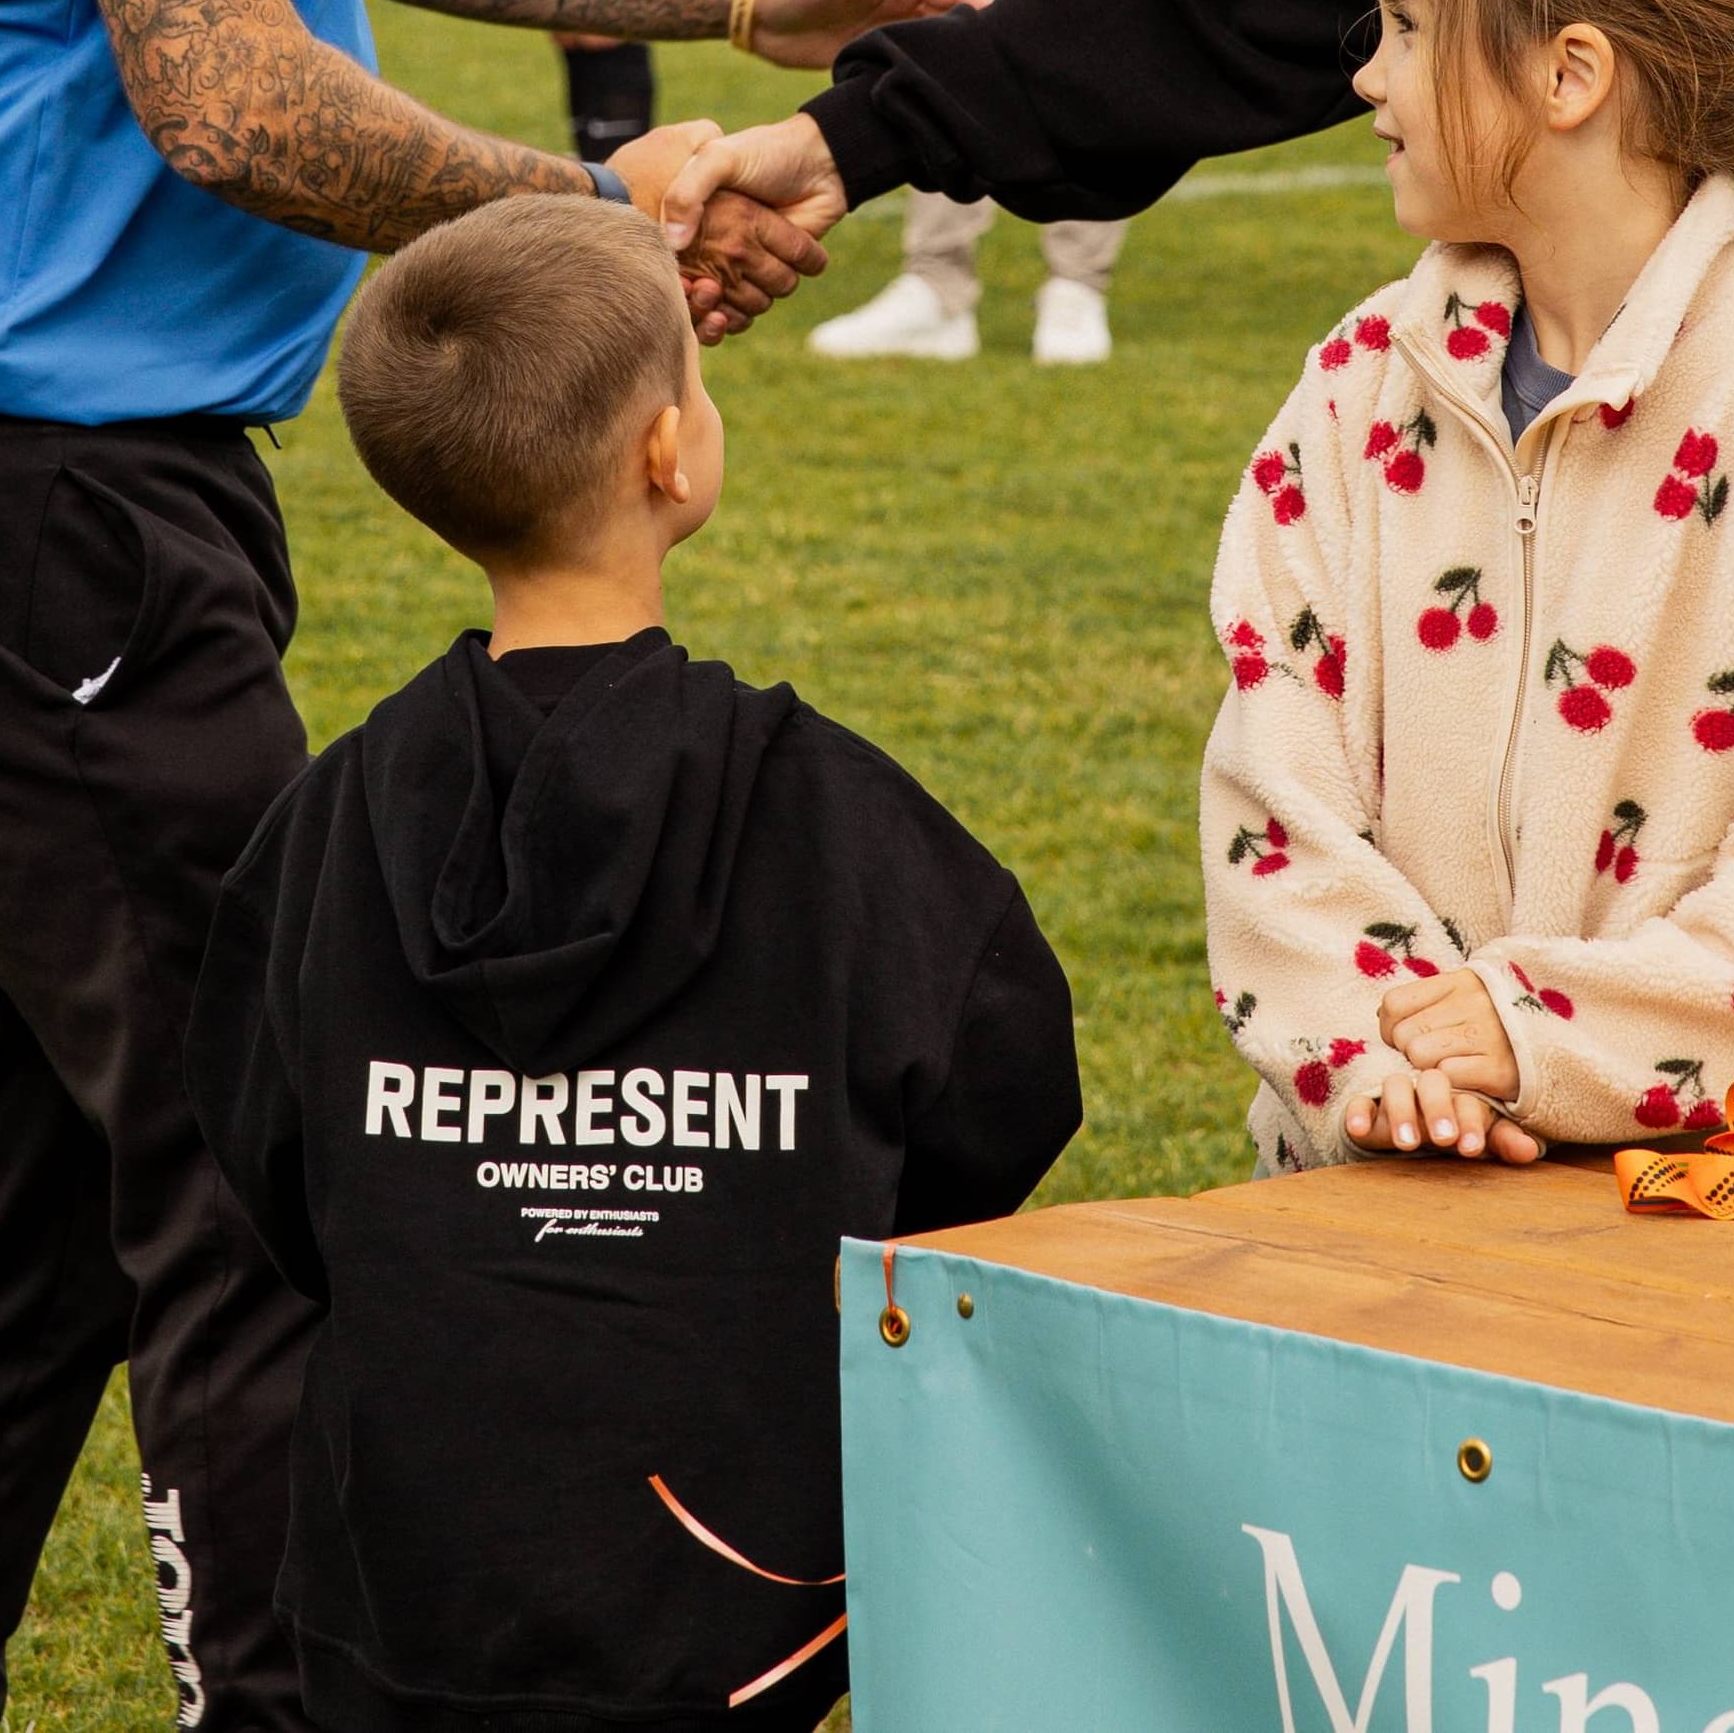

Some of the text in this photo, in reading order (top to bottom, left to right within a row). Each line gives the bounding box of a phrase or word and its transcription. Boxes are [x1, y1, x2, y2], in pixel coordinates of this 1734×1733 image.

[365, 1060, 809, 1151] REPRESENT
[476, 1162, 704, 1192] OWNERS' CLUB
[521, 1208, 659, 1222] POWERED BY ENTHUSIASTS
[534, 1218, 646, 1243] for enthusiasts
